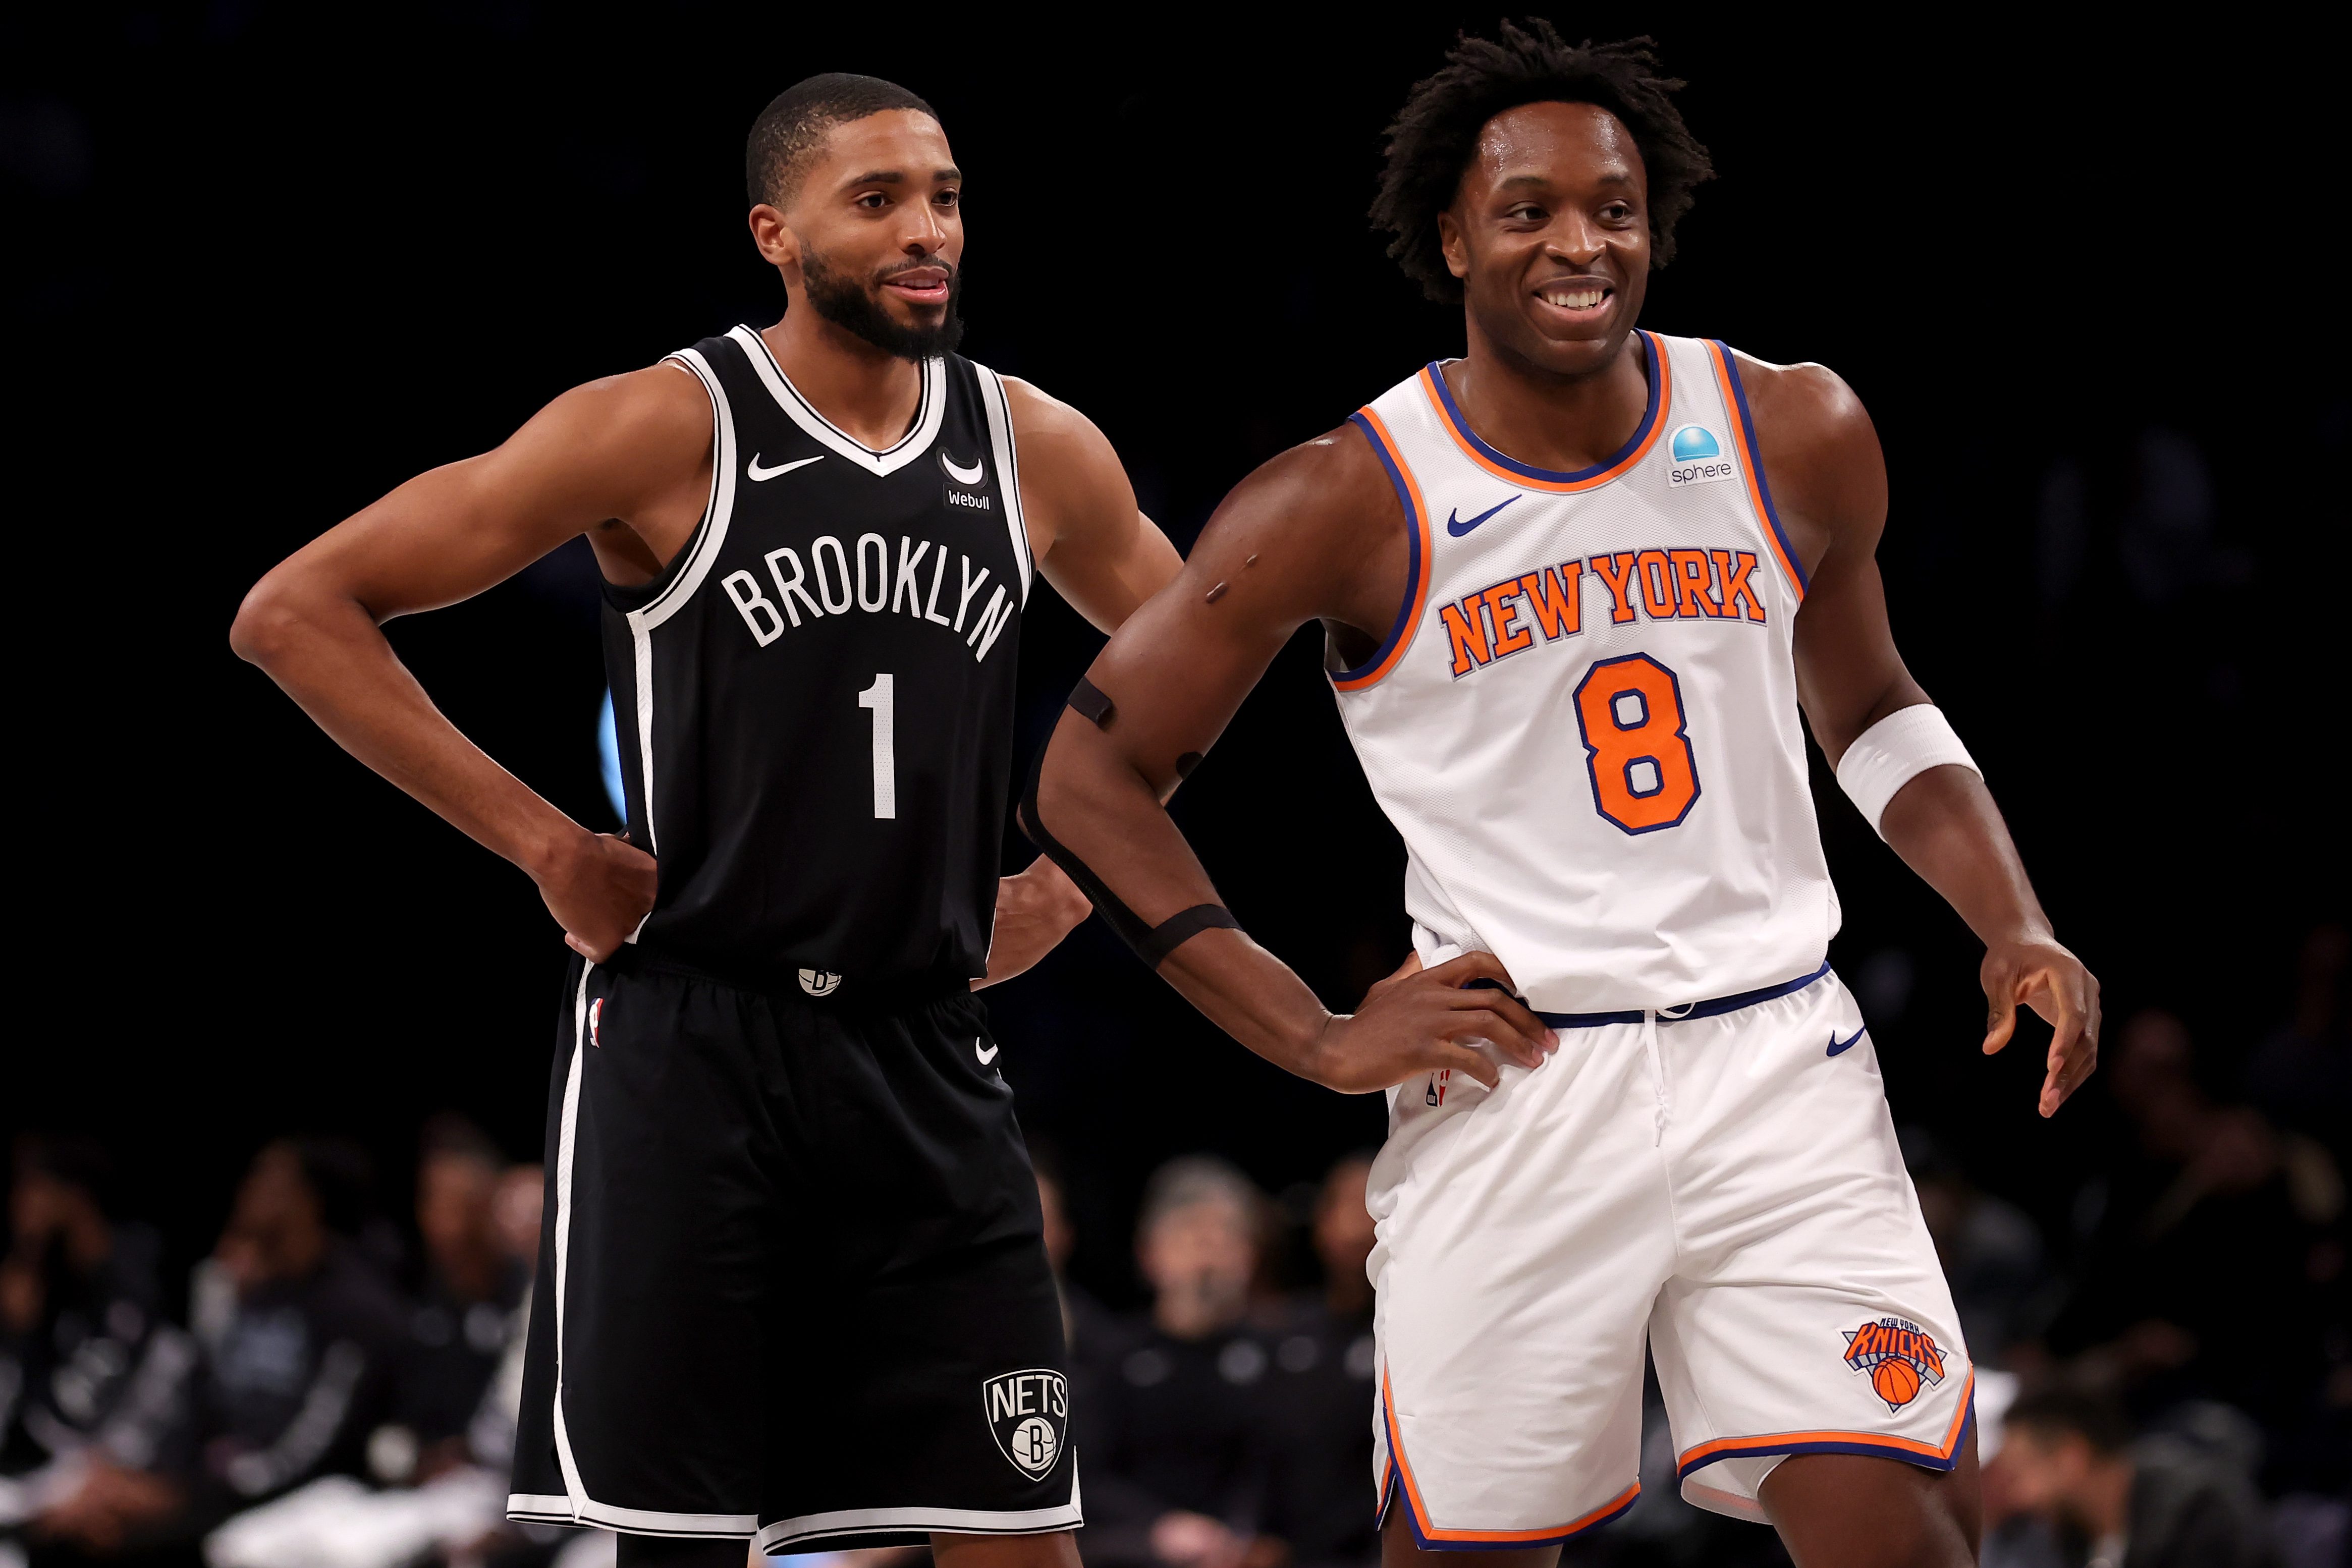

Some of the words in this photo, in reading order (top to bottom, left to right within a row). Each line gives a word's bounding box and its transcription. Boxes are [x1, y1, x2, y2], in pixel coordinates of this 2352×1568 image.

[948, 489, 990, 511] Webull
[1671, 463, 1732, 484] sphere
[721, 532, 1014, 663] BROOKLYN
[1439, 561, 1584, 679] NEW
[1589, 548, 1767, 625] YORK
[858, 674, 896, 819] 1
[1572, 651, 1702, 836] 8
[1843, 1321, 1945, 1378] KNICKS
[1880, 1317, 1898, 1327] NEW
[1899, 1319, 1920, 1334] YORK
[992, 1374, 1066, 1423] NETS
[1029, 1425, 1044, 1464] B
